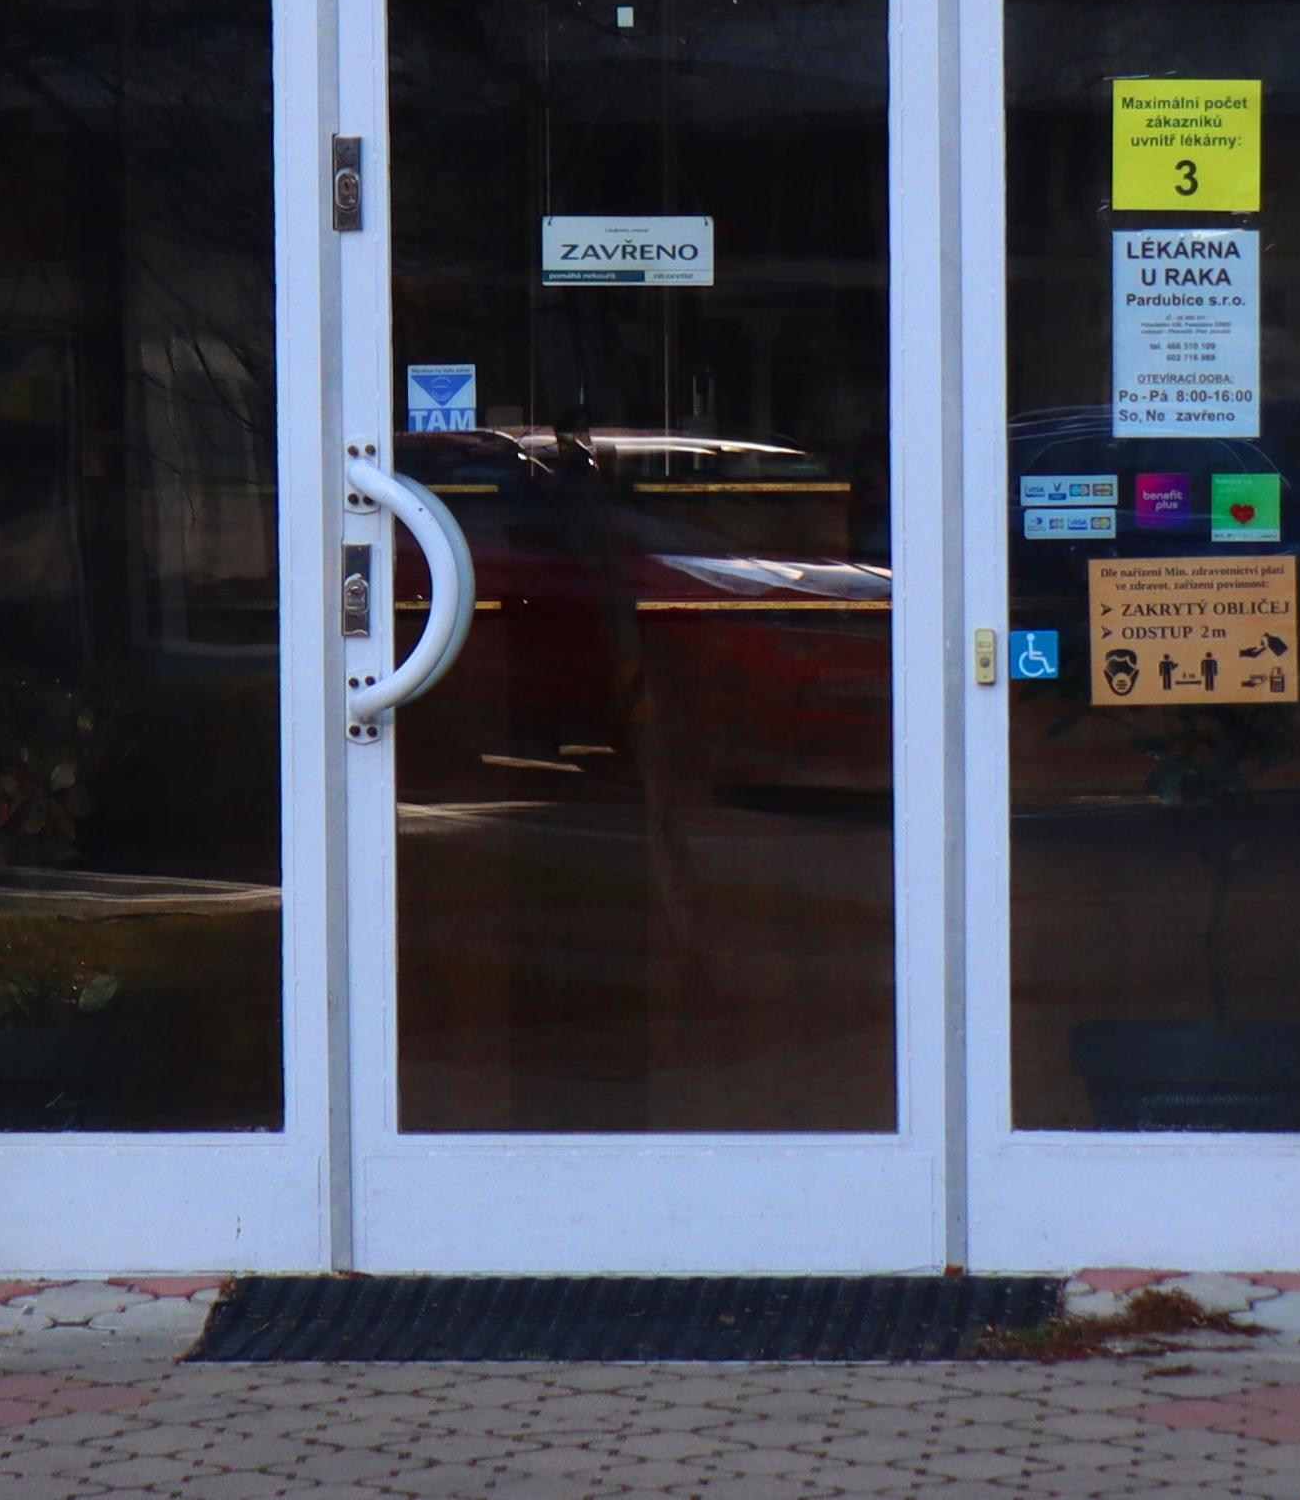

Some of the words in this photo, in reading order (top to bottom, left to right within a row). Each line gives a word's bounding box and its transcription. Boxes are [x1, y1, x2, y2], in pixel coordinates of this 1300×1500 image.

[1121, 96, 1199, 109] Maximální
[1204, 96, 1248, 112] počet
[1146, 114, 1222, 128] zákazníků
[1131, 133, 1175, 146] uvnitř
[1180, 133, 1242, 149] lékárny:
[1174, 159, 1198, 197] 3
[560, 239, 699, 260] ZAVŘENO
[1126, 237, 1241, 259] LÉKÁRNA
[1141, 268, 1156, 286] U
[1164, 268, 1232, 286] RAKA
[1126, 293, 1204, 306] Pardubice
[1208, 296, 1246, 306] s.r.o.
[1137, 372, 1196, 384] OTEVÍRACÍ
[1199, 373, 1235, 384] DOBA:
[1176, 390, 1252, 402] 8:00-16:00
[410, 409, 476, 432] TAM
[1119, 409, 1142, 424] So,
[1146, 409, 1165, 421] Ne
[1176, 409, 1235, 421] zavřeno
[1142, 490, 1183, 501] benefit
[1155, 500, 1178, 512] plus
[1101, 568, 1118, 577] Dle
[1115, 583, 1127, 591] ve
[1121, 600, 1208, 617] ZAKRYTÝ
[1213, 598, 1290, 616] OBLIČEJ
[1121, 626, 1193, 640] ODSTUP
[1201, 626, 1210, 638] 2
[1212, 629, 1226, 638] m
